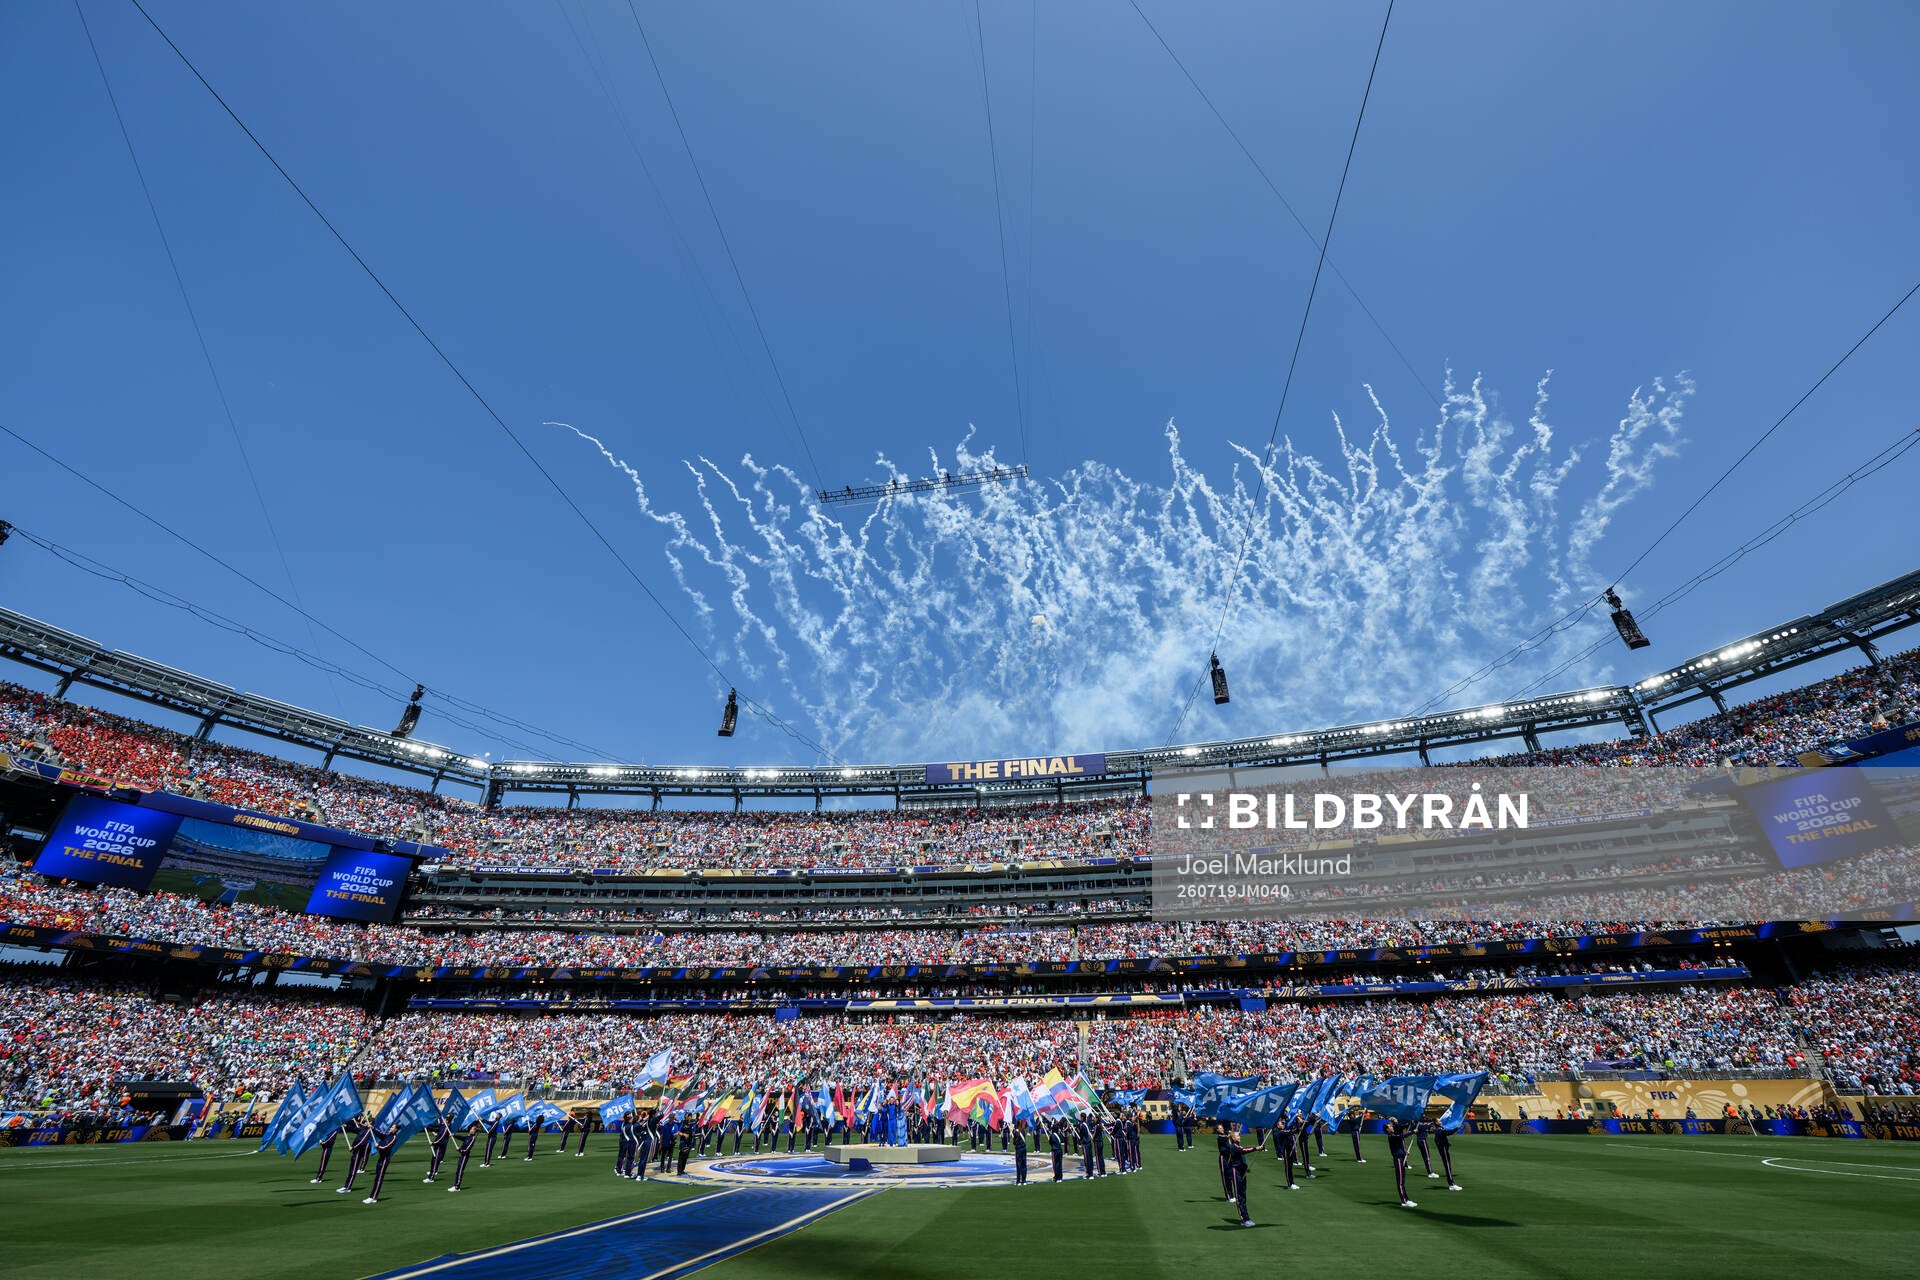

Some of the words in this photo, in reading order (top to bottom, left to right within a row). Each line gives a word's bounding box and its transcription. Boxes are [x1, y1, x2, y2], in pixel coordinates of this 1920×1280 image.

[947, 761, 999, 780] THE
[1004, 757, 1084, 777] FINAL
[1794, 793, 1828, 808] FIFA
[1774, 805, 1828, 824] WORLD
[1830, 797, 1862, 812] CUP
[233, 814, 299, 835] #FIFAWorldCup
[1527, 820, 1549, 829] NEW
[1550, 818, 1578, 827] YORK
[1579, 815, 1602, 824] NEW
[1603, 810, 1645, 821] JERSEY
[1796, 813, 1851, 831] 2026
[104, 820, 135, 834] FIFA
[1785, 832, 1822, 844] THE
[1823, 819, 1878, 837] FINAL
[74, 825, 127, 843] WORLD
[128, 836, 156, 848] CUP
[82, 839, 135, 856] 2026
[63, 846, 95, 860] THE
[97, 852, 144, 868] FINAL
[353, 866, 377, 877] FIFA
[332, 871, 371, 885] WORLD
[371, 879, 393, 888] CUP
[339, 882, 378, 895] 2026
[326, 889, 350, 900] THE
[350, 894, 386, 905] FINAL
[1862, 911, 1891, 921] FIFA
[9, 927, 35, 938] FIFA
[1697, 931, 1721, 939] THE
[1721, 928, 1756, 938] FINAL
[108, 939, 130, 948] THE
[131, 942, 163, 952] FINAL
[1595, 937, 1618, 945] FIFA
[1424, 947, 1451, 956] FINAL
[1505, 943, 1525, 951] FIFA
[224, 952, 244, 960] FIFA
[1263, 955, 1280, 963] FIFA
[1339, 952, 1357, 960] FIFA
[1194, 958, 1217, 966] FINAL
[1650, 1091, 1677, 1100] FIFA
[242, 1126, 264, 1136] FIFA
[1477, 1122, 1502, 1132] FIFA
[1620, 1122, 1645, 1132] FIFA
[1687, 1122, 1715, 1132] FIFA
[1831, 1123, 1858, 1136] FIFA
[28, 1131, 59, 1143] FIFA
[106, 1130, 133, 1140] FIFA
